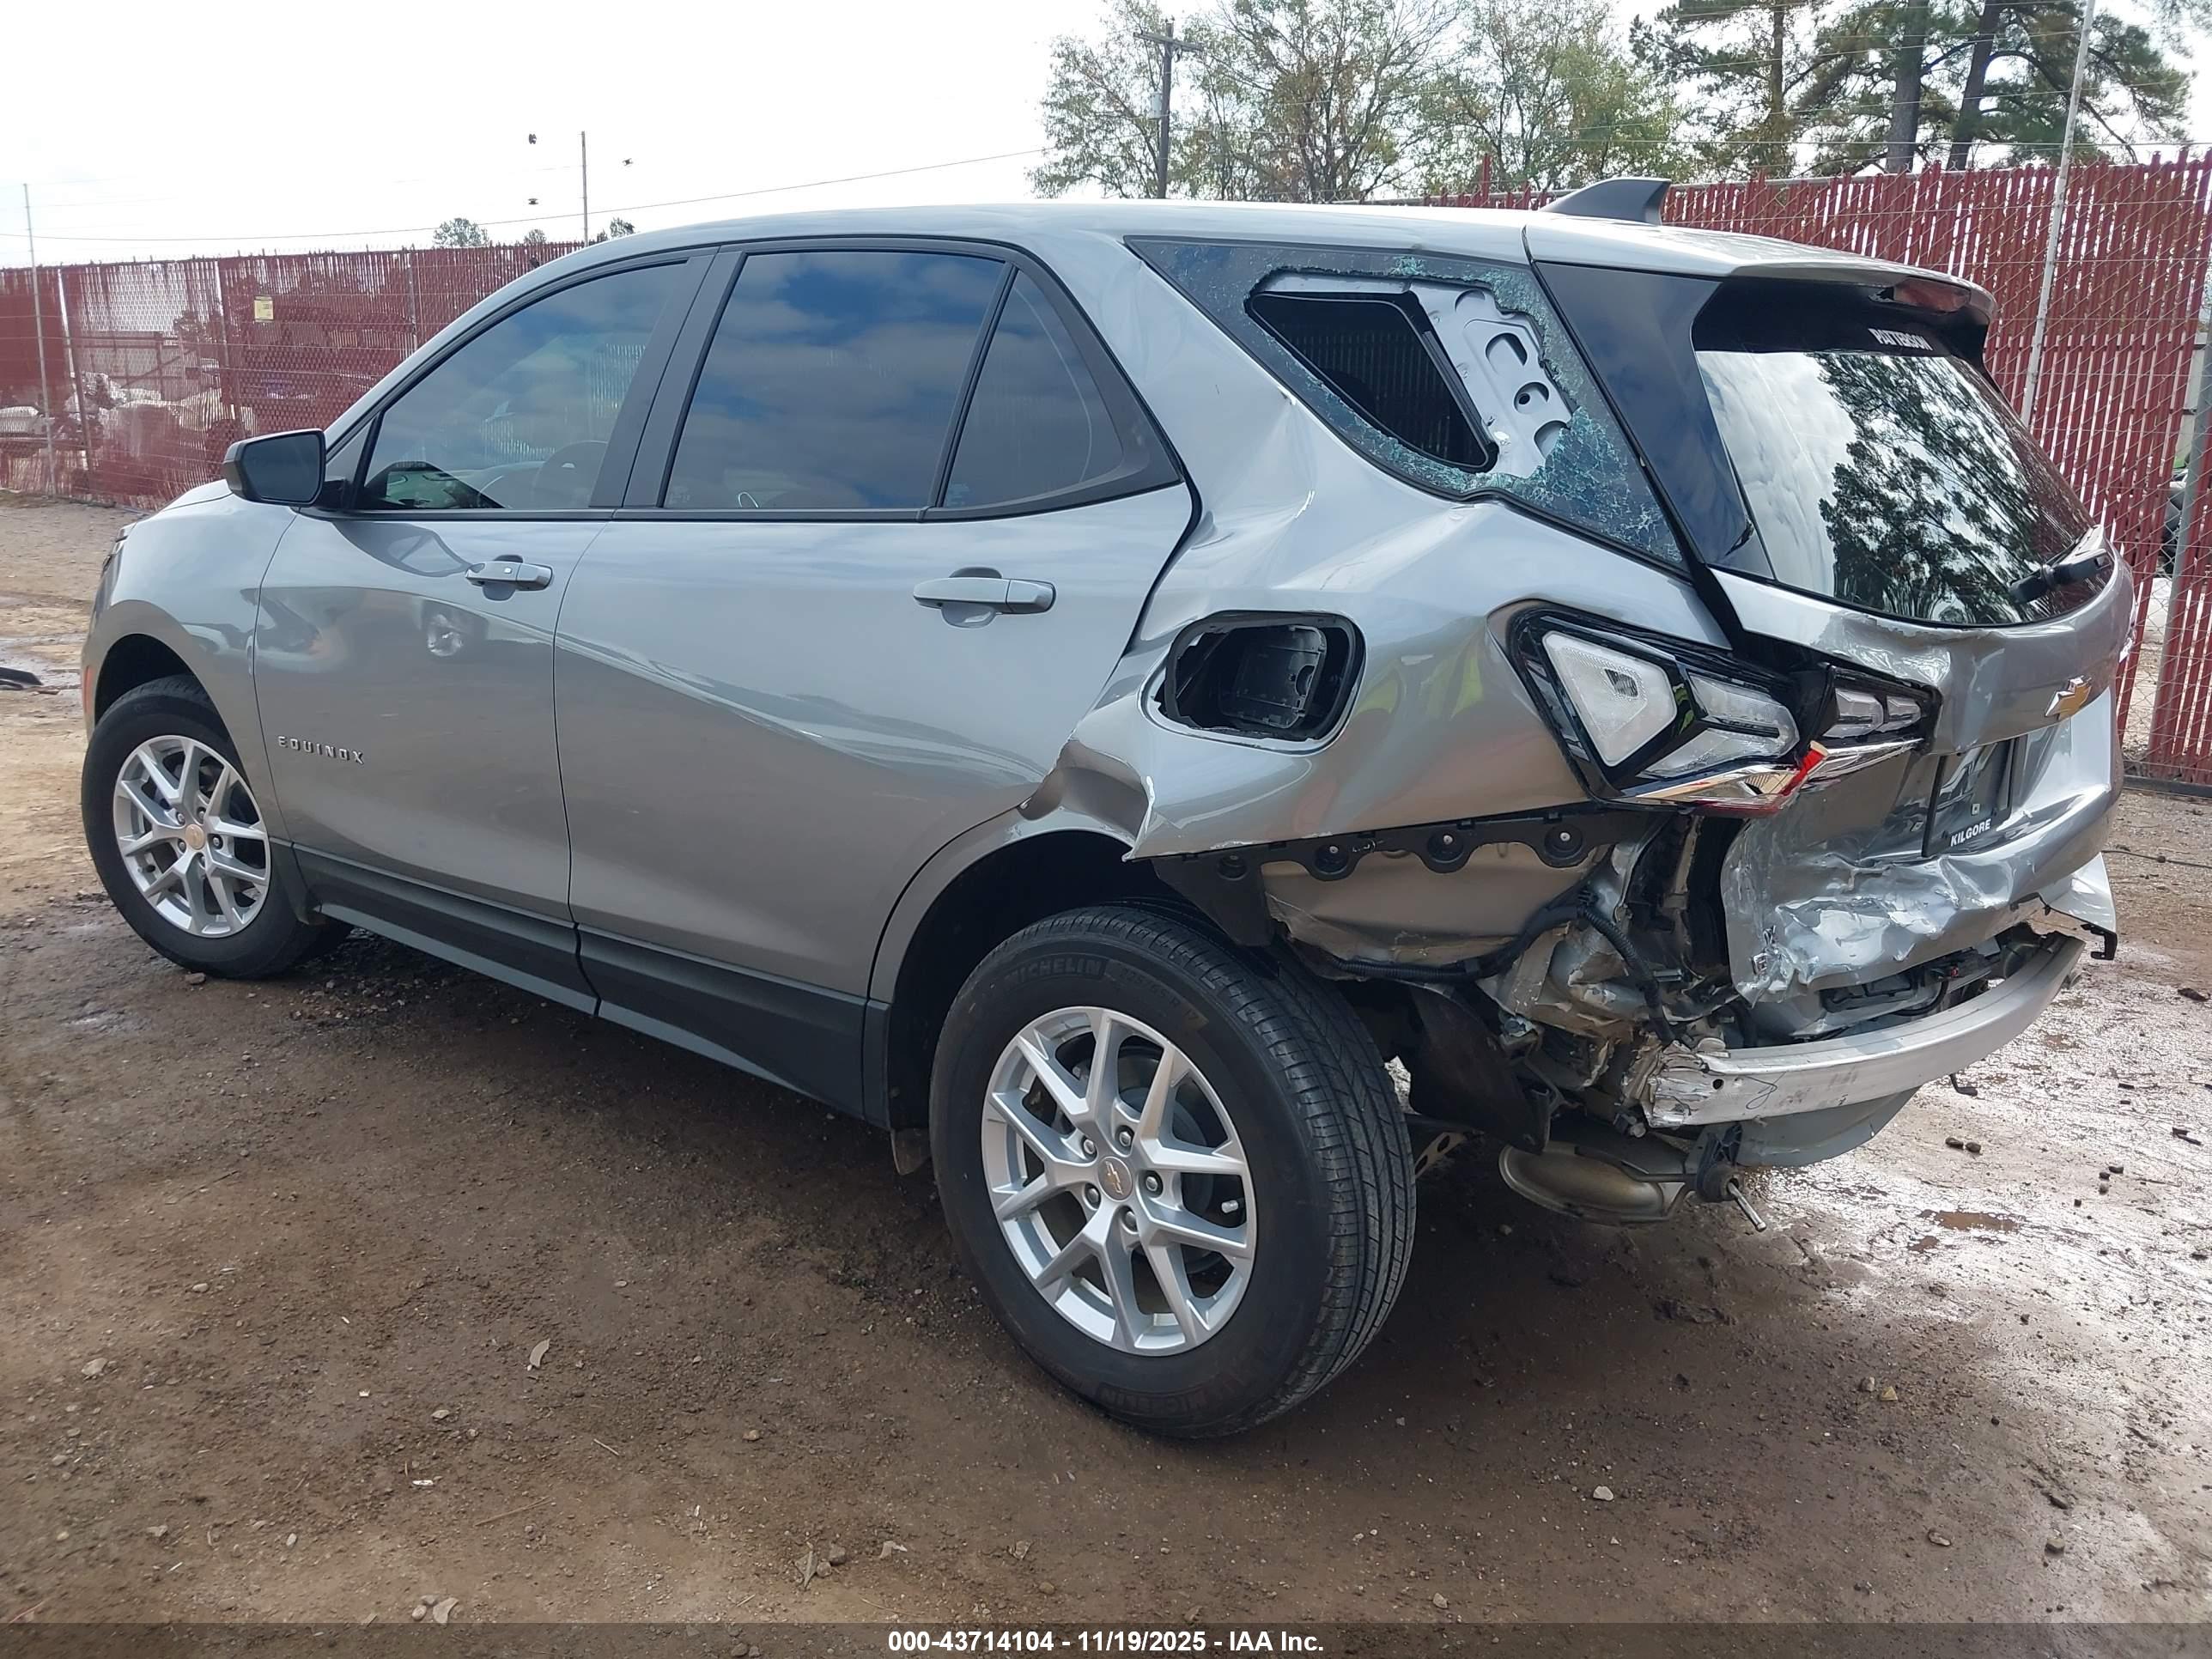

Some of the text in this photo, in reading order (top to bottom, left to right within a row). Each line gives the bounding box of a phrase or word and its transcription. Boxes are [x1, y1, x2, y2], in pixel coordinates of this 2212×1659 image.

[1868, 327, 1934, 351] PATTERSON
[277, 736, 365, 765] EQUINOX
[1950, 818, 1992, 847] KILGORE
